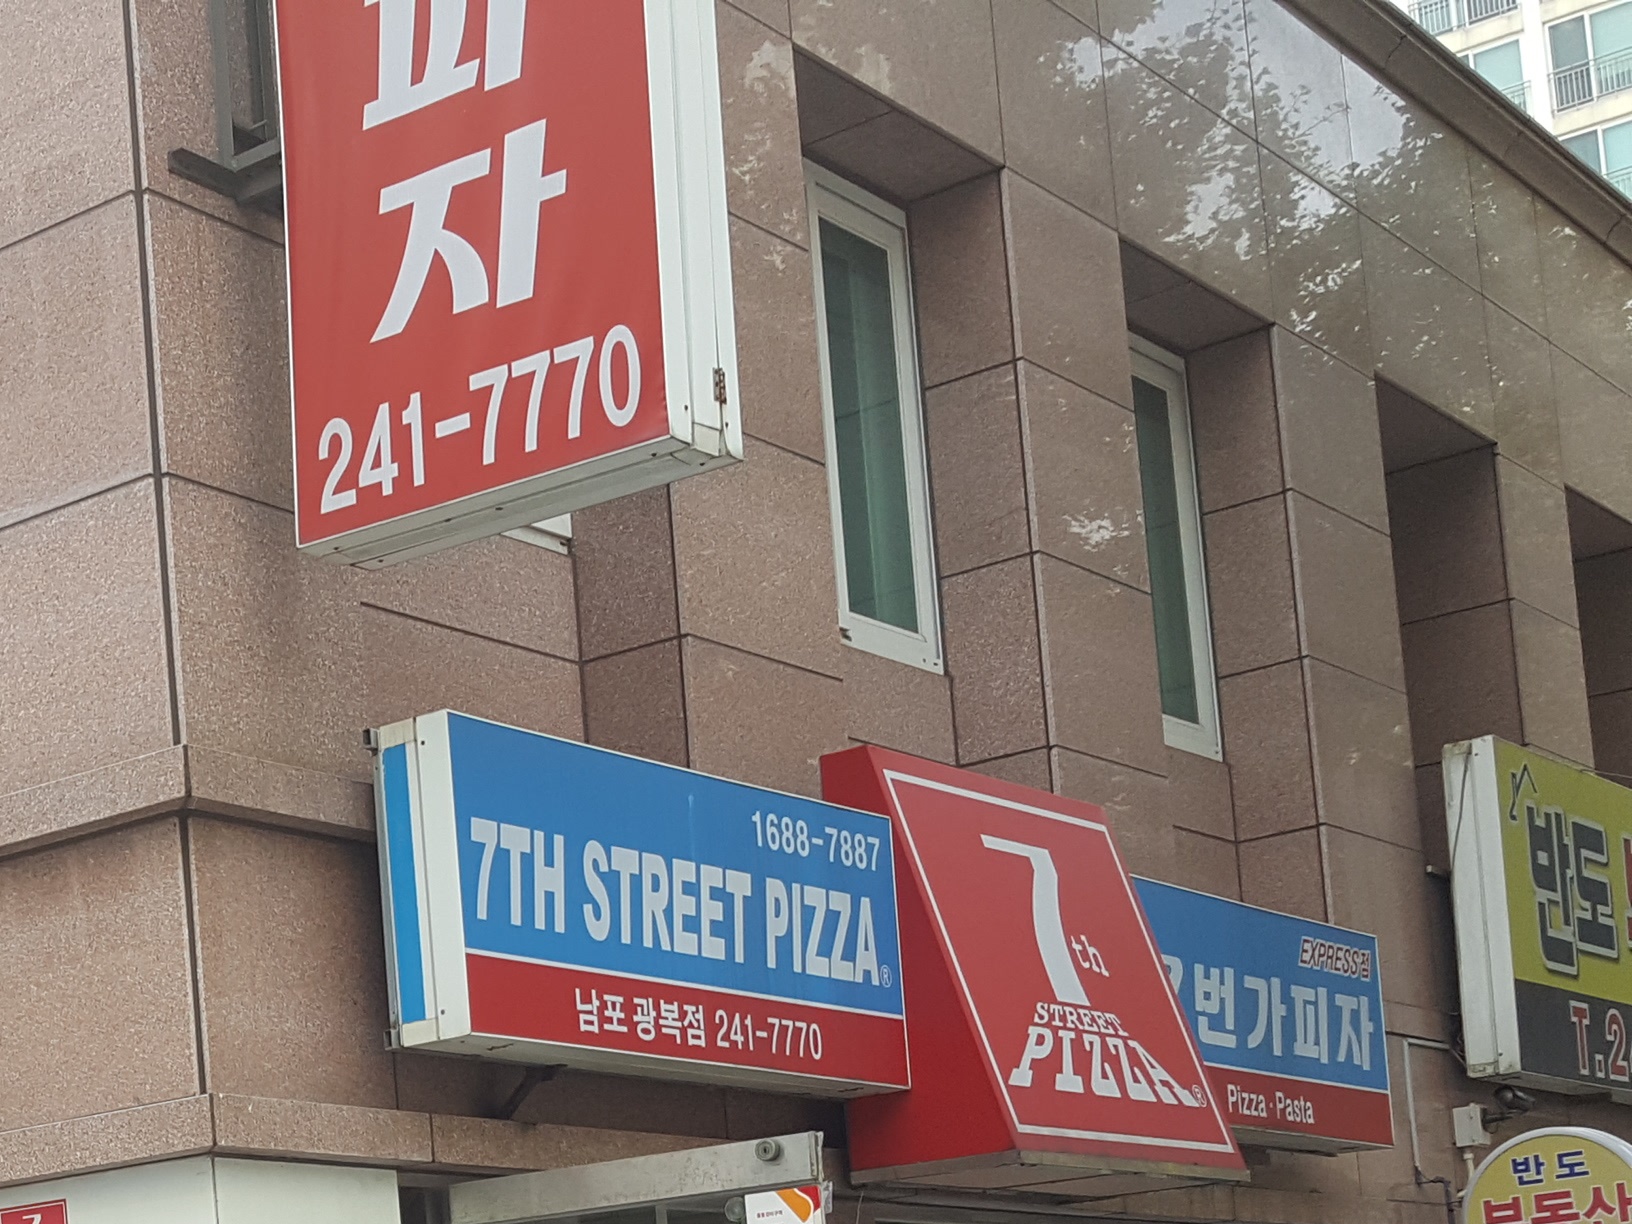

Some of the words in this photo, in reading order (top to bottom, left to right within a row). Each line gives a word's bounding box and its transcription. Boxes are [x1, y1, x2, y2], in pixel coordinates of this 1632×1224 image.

[318, 323, 642, 515] 241-7770
[752, 810, 880, 871] 1688-7887
[471, 816, 565, 934] 7TH
[582, 839, 751, 964] STREET
[765, 877, 880, 986] PIZZA
[715, 1008, 823, 1060] 241-7770
[1033, 1002, 1129, 1038] STREET
[1569, 1000, 1632, 1083] T.2
[1008, 1025, 1202, 1108] PIZZA
[1227, 1083, 1267, 1119] Pizza
[1275, 1091, 1314, 1125] Pasta
[1511, 1150, 1590, 1186] 반도
